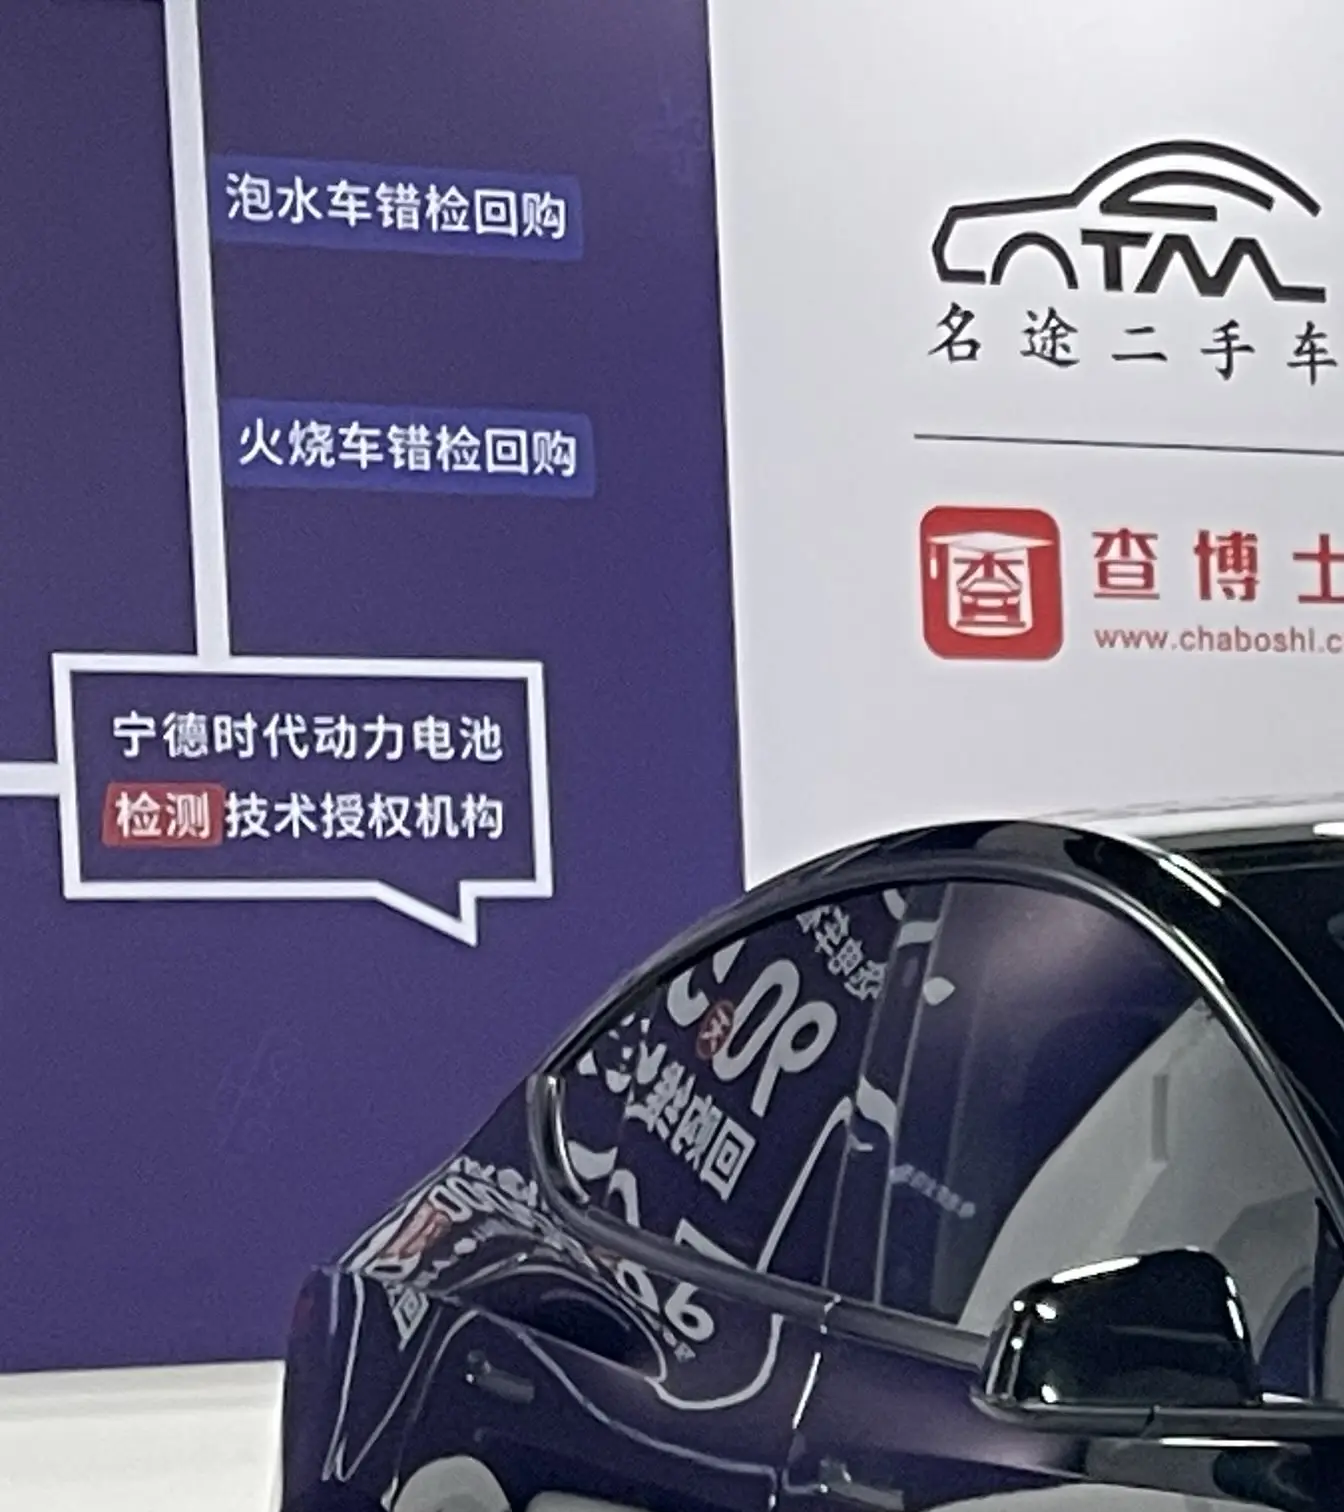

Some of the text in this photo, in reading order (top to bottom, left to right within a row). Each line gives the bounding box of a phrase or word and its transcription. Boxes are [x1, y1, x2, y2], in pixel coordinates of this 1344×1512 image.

[226, 172, 567, 240] 泡水车错检回购
[927, 301, 1338, 385] 名途二手车
[239, 417, 577, 478] 火烧车错检回购
[112, 711, 504, 761] 宁德时代动力电池
[116, 792, 504, 840] 检测 技术授权机构
